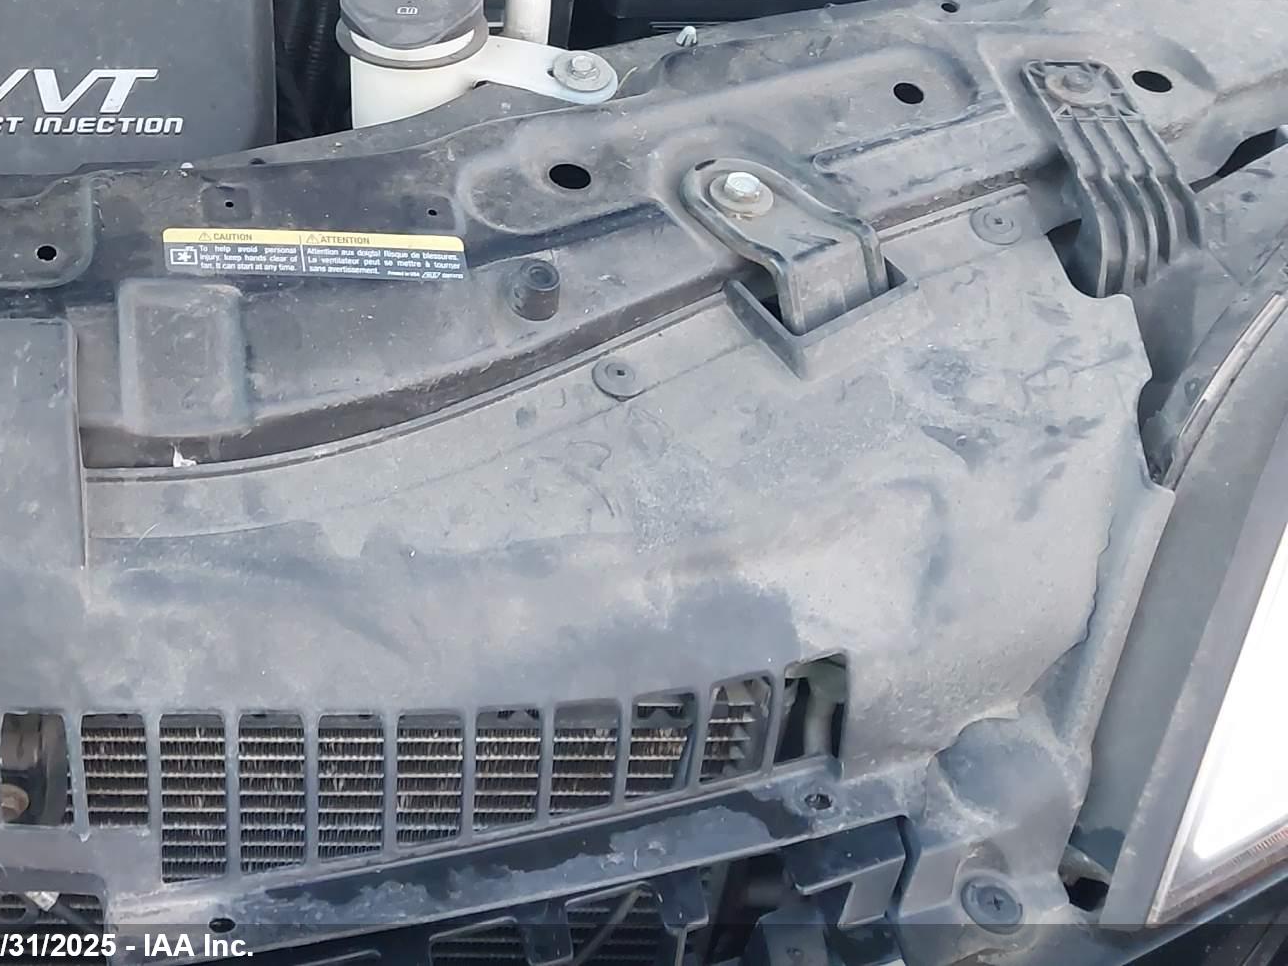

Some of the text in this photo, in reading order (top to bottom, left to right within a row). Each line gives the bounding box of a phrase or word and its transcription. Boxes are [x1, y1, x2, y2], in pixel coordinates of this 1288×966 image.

[33, 116, 184, 134] INJECTION
[214, 233, 252, 241] CAUTION
[320, 237, 370, 245] ATTENTION
[215, 245, 231, 253] help
[224, 254, 242, 262] keep
[244, 254, 266, 262] hands
[384, 250, 408, 260] Risque
[423, 252, 459, 260] blessures.
[321, 257, 359, 265] ventilateur
[264, 264, 278, 272] any
[328, 266, 380, 275] avertissement.
